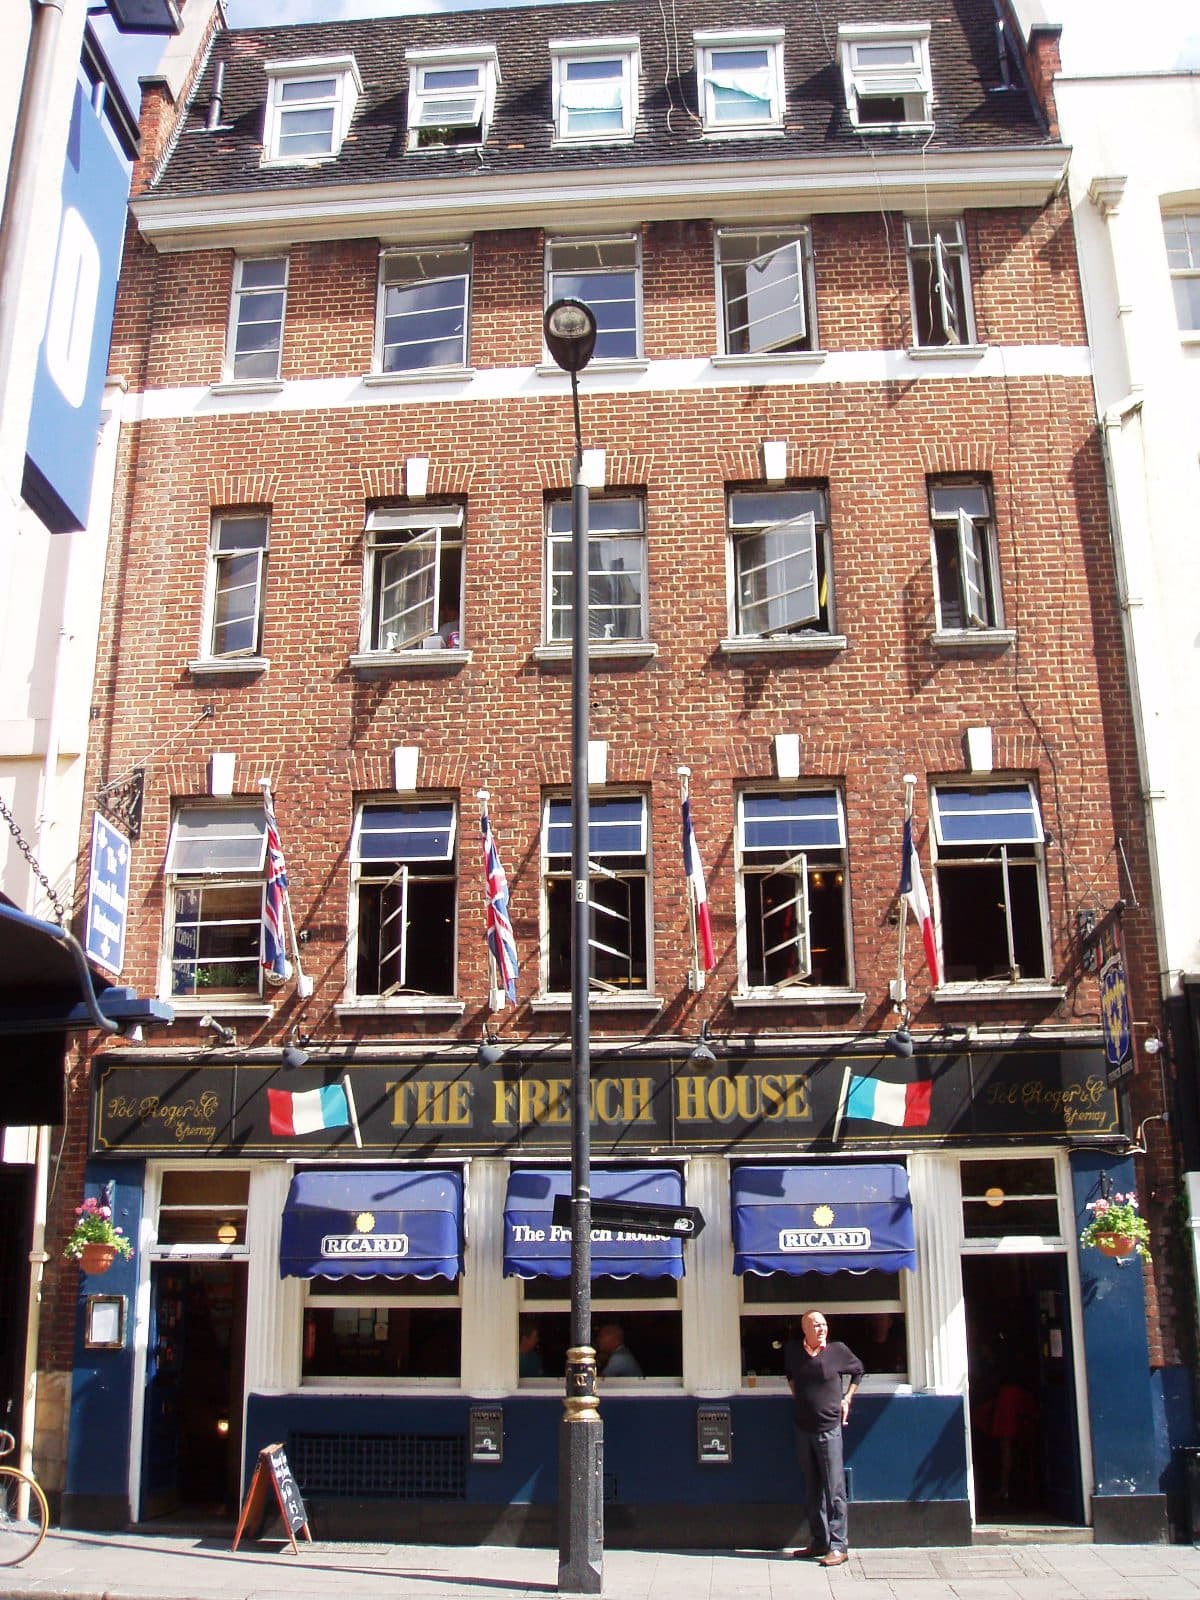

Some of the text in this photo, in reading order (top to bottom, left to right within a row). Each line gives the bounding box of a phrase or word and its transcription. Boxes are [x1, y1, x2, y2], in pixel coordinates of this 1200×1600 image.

[386, 1081, 474, 1128] THE
[676, 1074, 811, 1122] HOUSE
[107, 1096, 138, 1118] Pol
[138, 1096, 195, 1127] Roger
[512, 1225, 545, 1242] The
[549, 1225, 613, 1242] Frch
[785, 1231, 864, 1247] RICARD
[326, 1239, 402, 1253] RICARD
